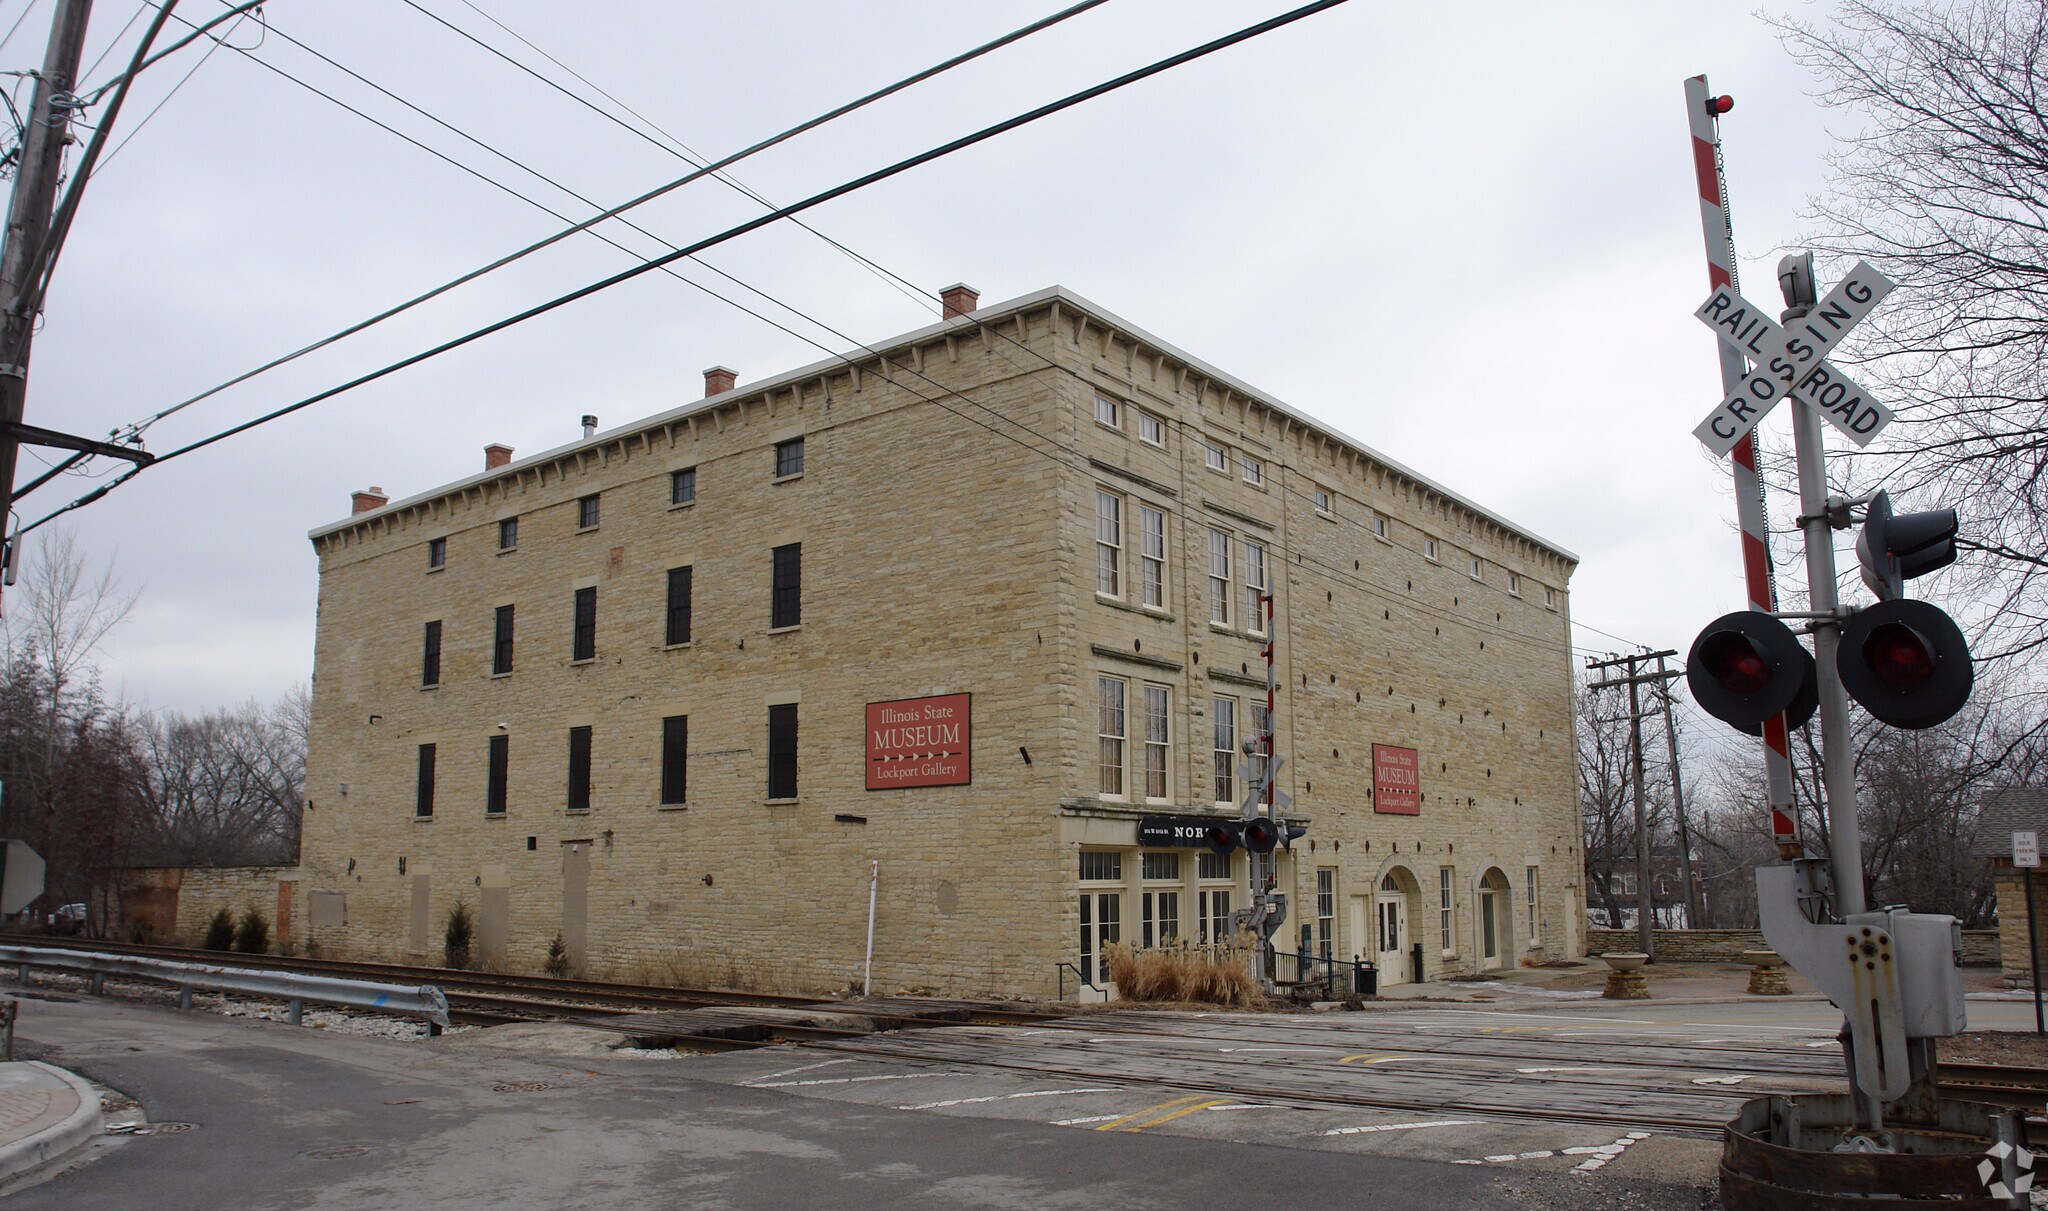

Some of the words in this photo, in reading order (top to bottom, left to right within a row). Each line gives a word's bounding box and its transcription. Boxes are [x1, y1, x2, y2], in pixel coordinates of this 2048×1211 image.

[1703, 292, 1769, 355] RAIL
[1799, 367, 1880, 434] ROAD
[1711, 280, 1873, 439] CROSSING
[880, 708, 920, 724] Illinois
[924, 704, 954, 720] State
[874, 723, 960, 750] MUSEUM
[877, 765, 919, 780] Lockport
[921, 762, 957, 777] Gallery
[1377, 766, 1416, 786] MUSEUM
